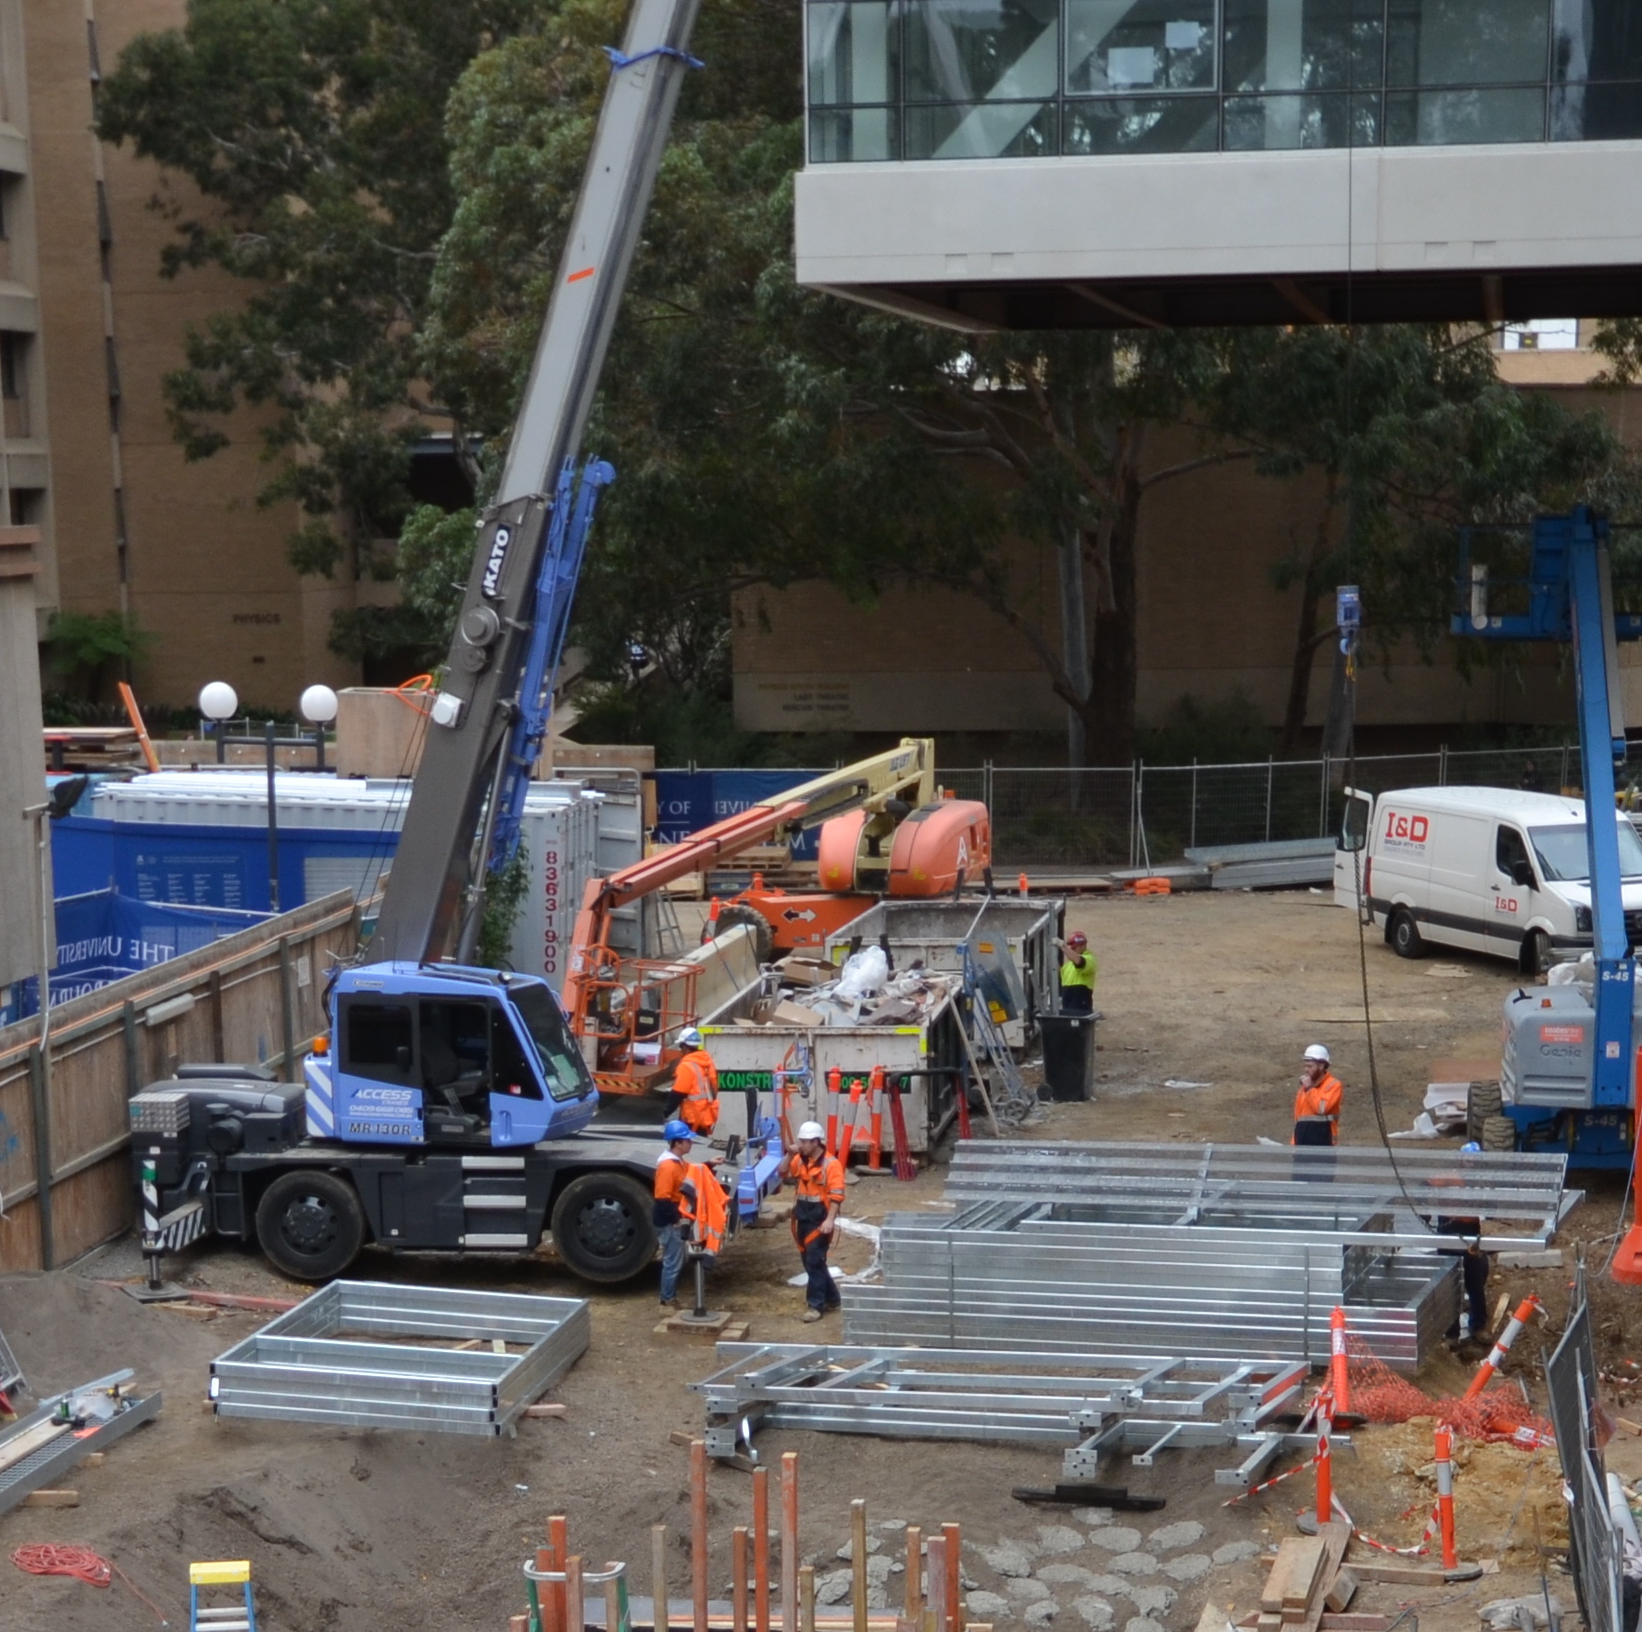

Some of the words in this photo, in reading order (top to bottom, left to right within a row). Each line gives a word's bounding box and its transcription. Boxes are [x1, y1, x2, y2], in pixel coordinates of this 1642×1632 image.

[483, 529, 509, 588] KATO
[1385, 812, 1429, 843] I&D
[544, 850, 558, 974] 83631900
[1495, 896, 1518, 913] I&D
[1602, 971, 1630, 982] S-45
[351, 1088, 413, 1100] ACCESS
[349, 1121, 371, 1135] MR
[1584, 1115, 1618, 1127] S-45
